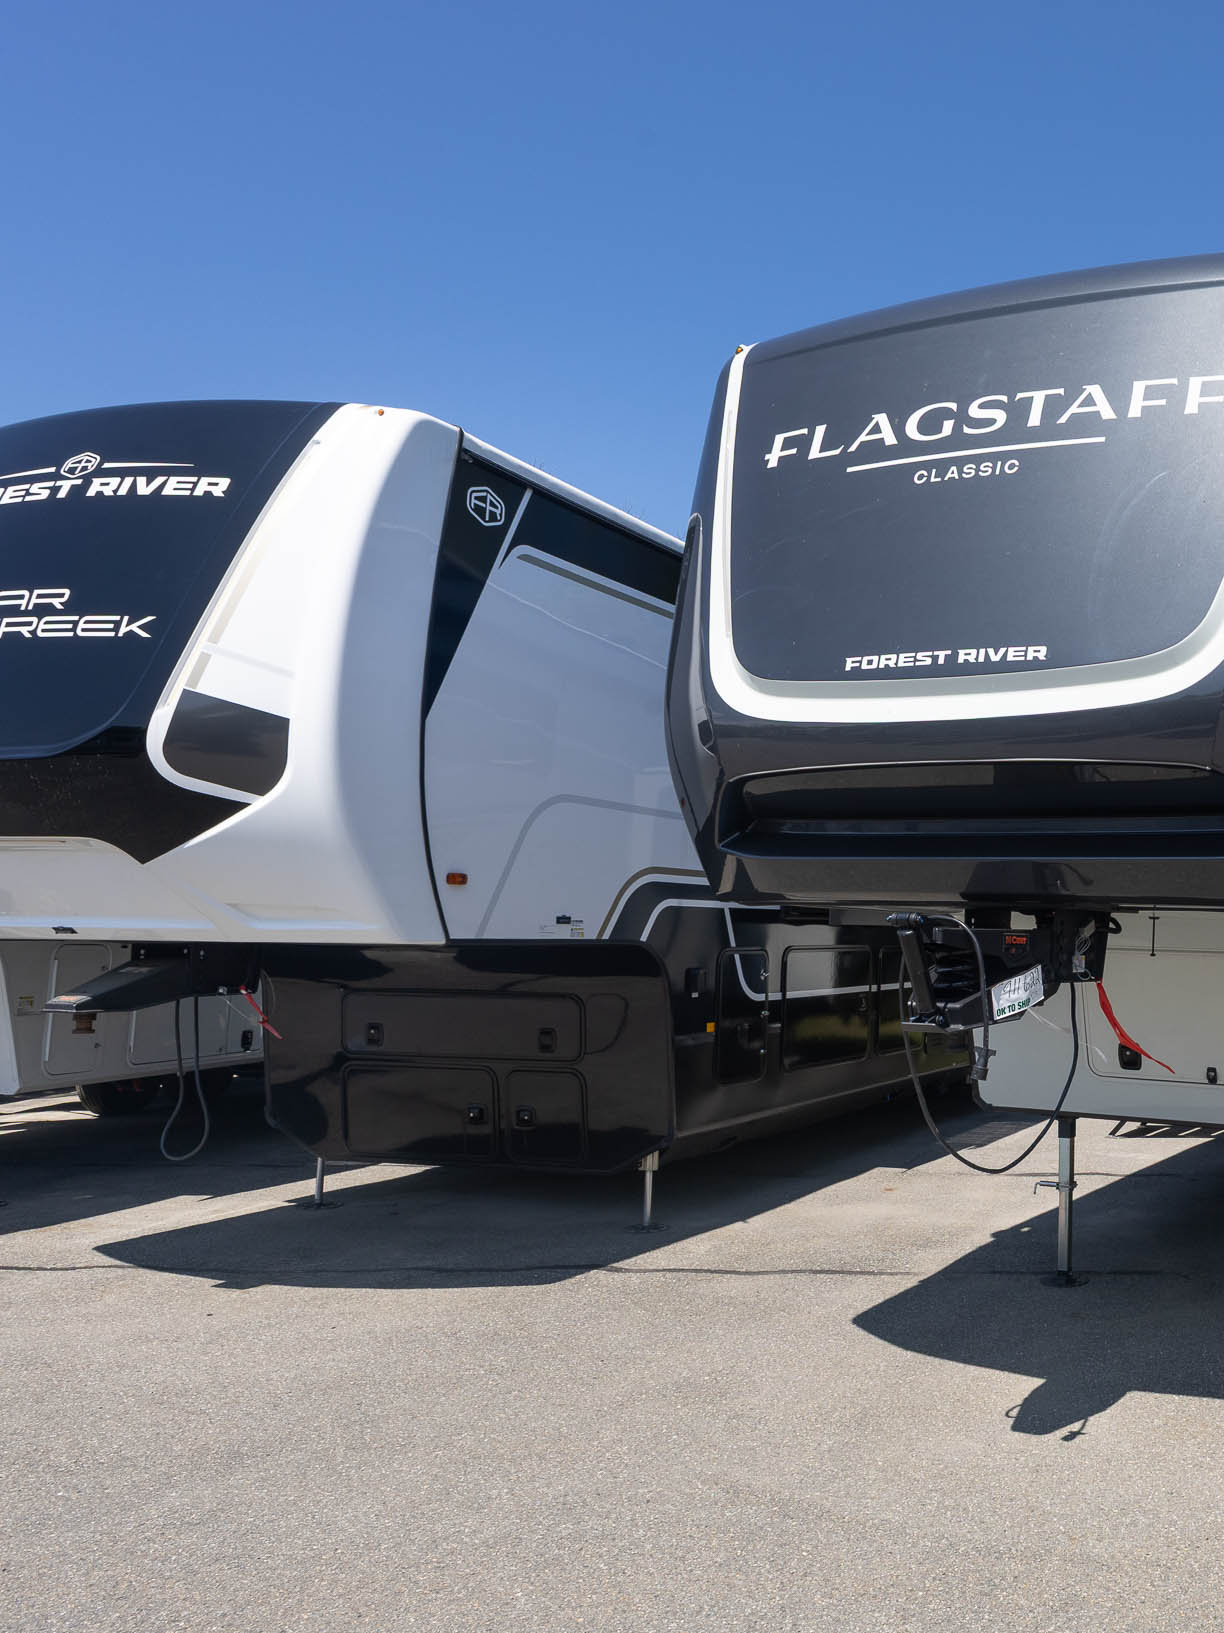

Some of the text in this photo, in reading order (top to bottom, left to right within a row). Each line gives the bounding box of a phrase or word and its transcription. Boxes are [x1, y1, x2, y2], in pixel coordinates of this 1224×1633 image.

[912, 458, 1021, 485] CLASSIC
[0, 475, 232, 505] EST RIVER
[844, 644, 1048, 672] FOREST RIVER
[996, 997, 1030, 1017] OK TO SHIP
